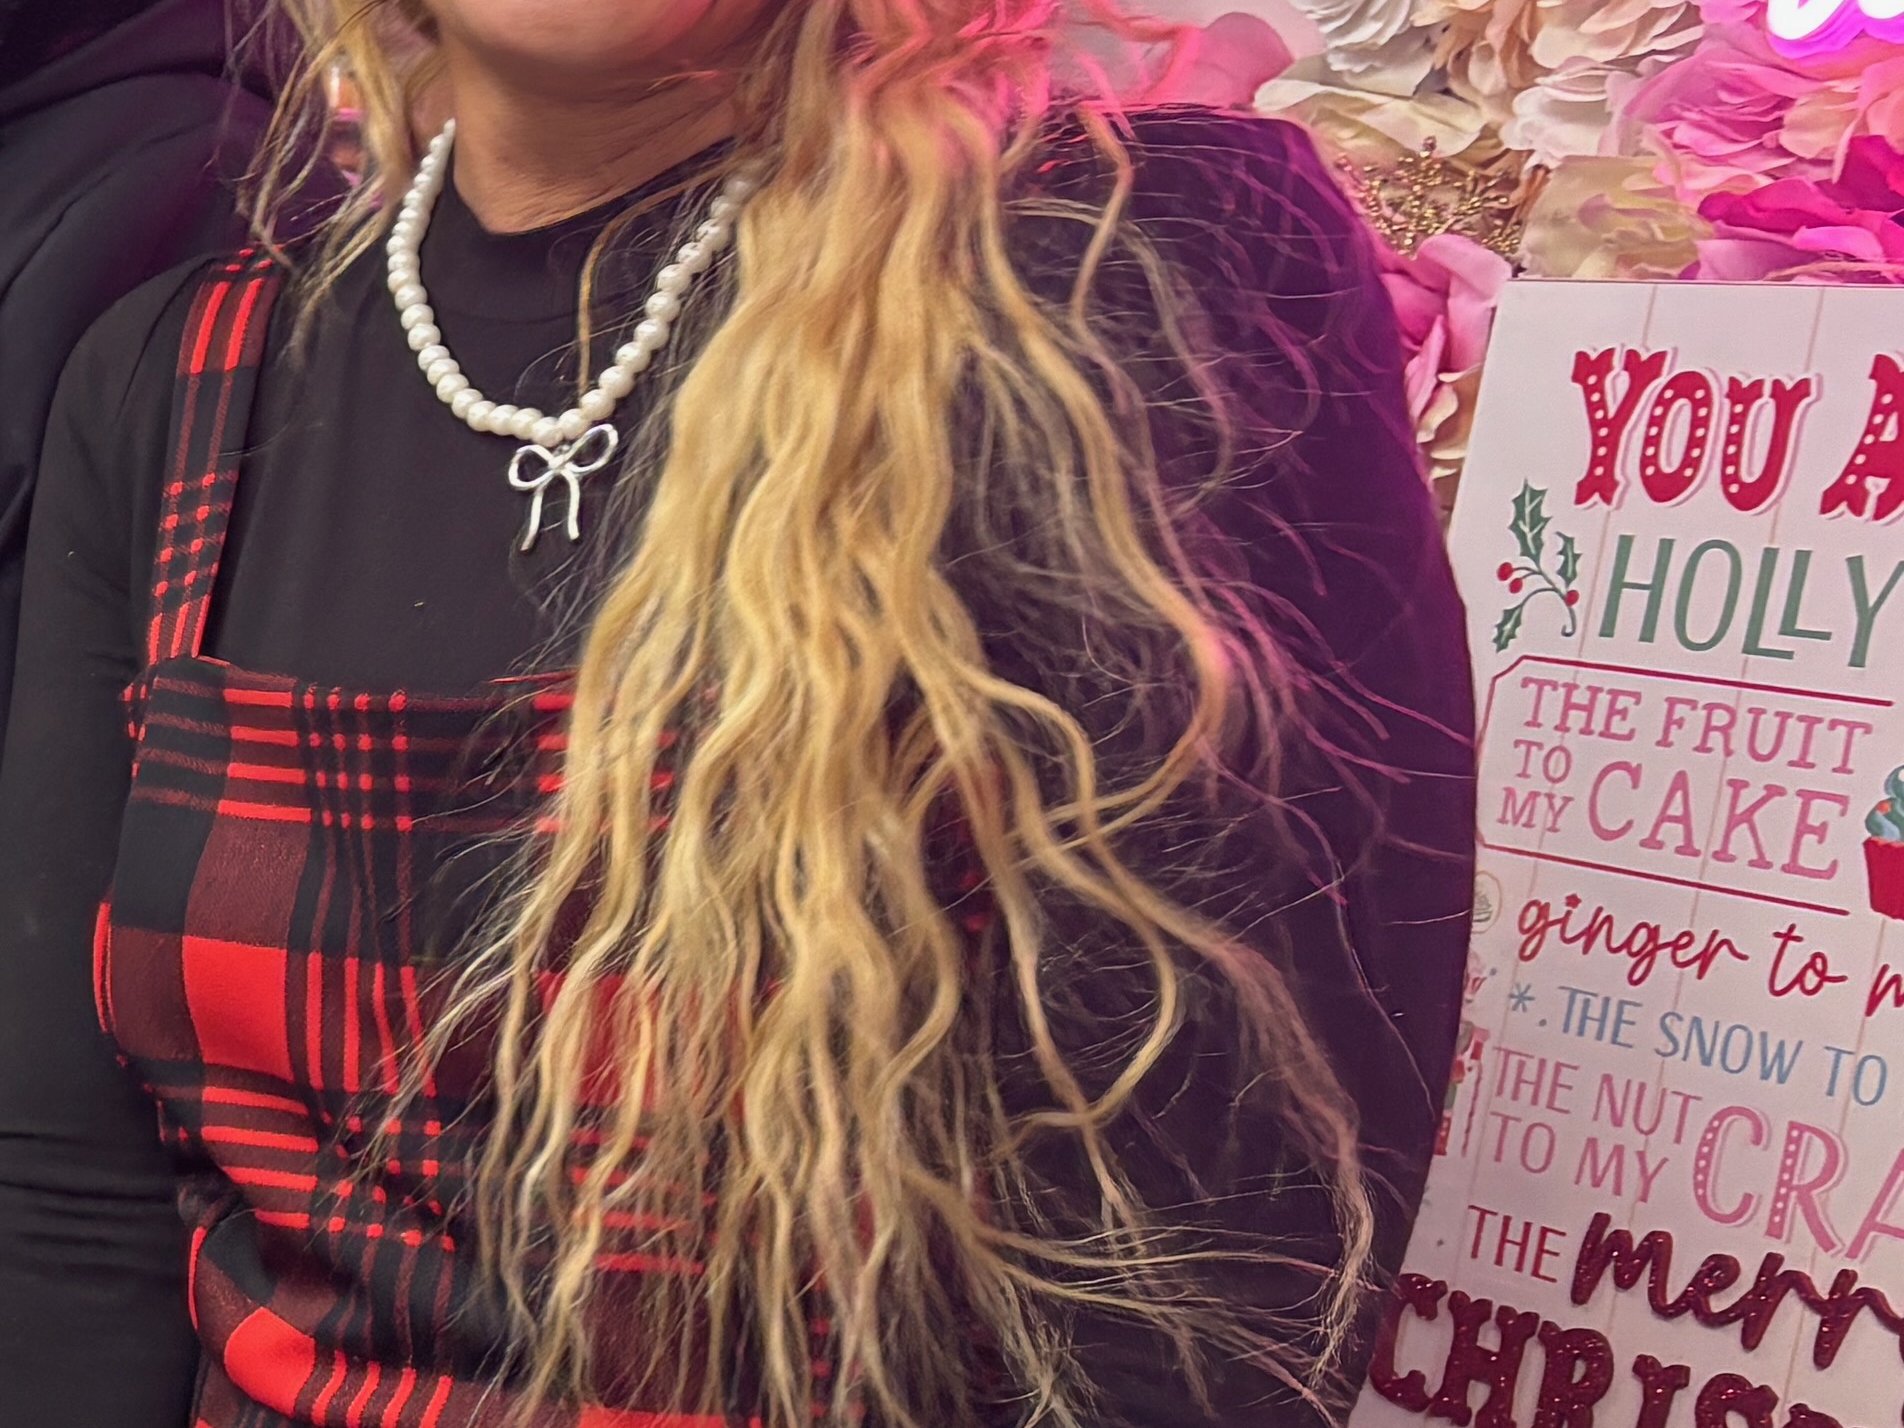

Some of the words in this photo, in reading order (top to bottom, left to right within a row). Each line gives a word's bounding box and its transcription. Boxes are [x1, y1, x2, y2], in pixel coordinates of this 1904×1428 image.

[1571, 347, 1813, 512] YOU
[1599, 534, 1904, 668] HOLLY
[1513, 739, 1574, 784] TO
[1521, 676, 1642, 742] THE
[1655, 697, 1873, 775] FRUIT
[1496, 787, 1574, 834] MY
[1588, 760, 1850, 880] CAKE
[1518, 893, 1750, 987] ginger
[1769, 923, 1848, 997] to
[1494, 1046, 1580, 1115] THE
[1594, 1072, 1704, 1145] NUT
[1558, 985, 1644, 1049] THE
[1655, 1010, 1805, 1085] SNOW
[1824, 1044, 1888, 1106] TO
[1490, 1110, 1556, 1174] TO
[1574, 1136, 1670, 1204] MY
[1468, 1203, 1567, 1284] THE
